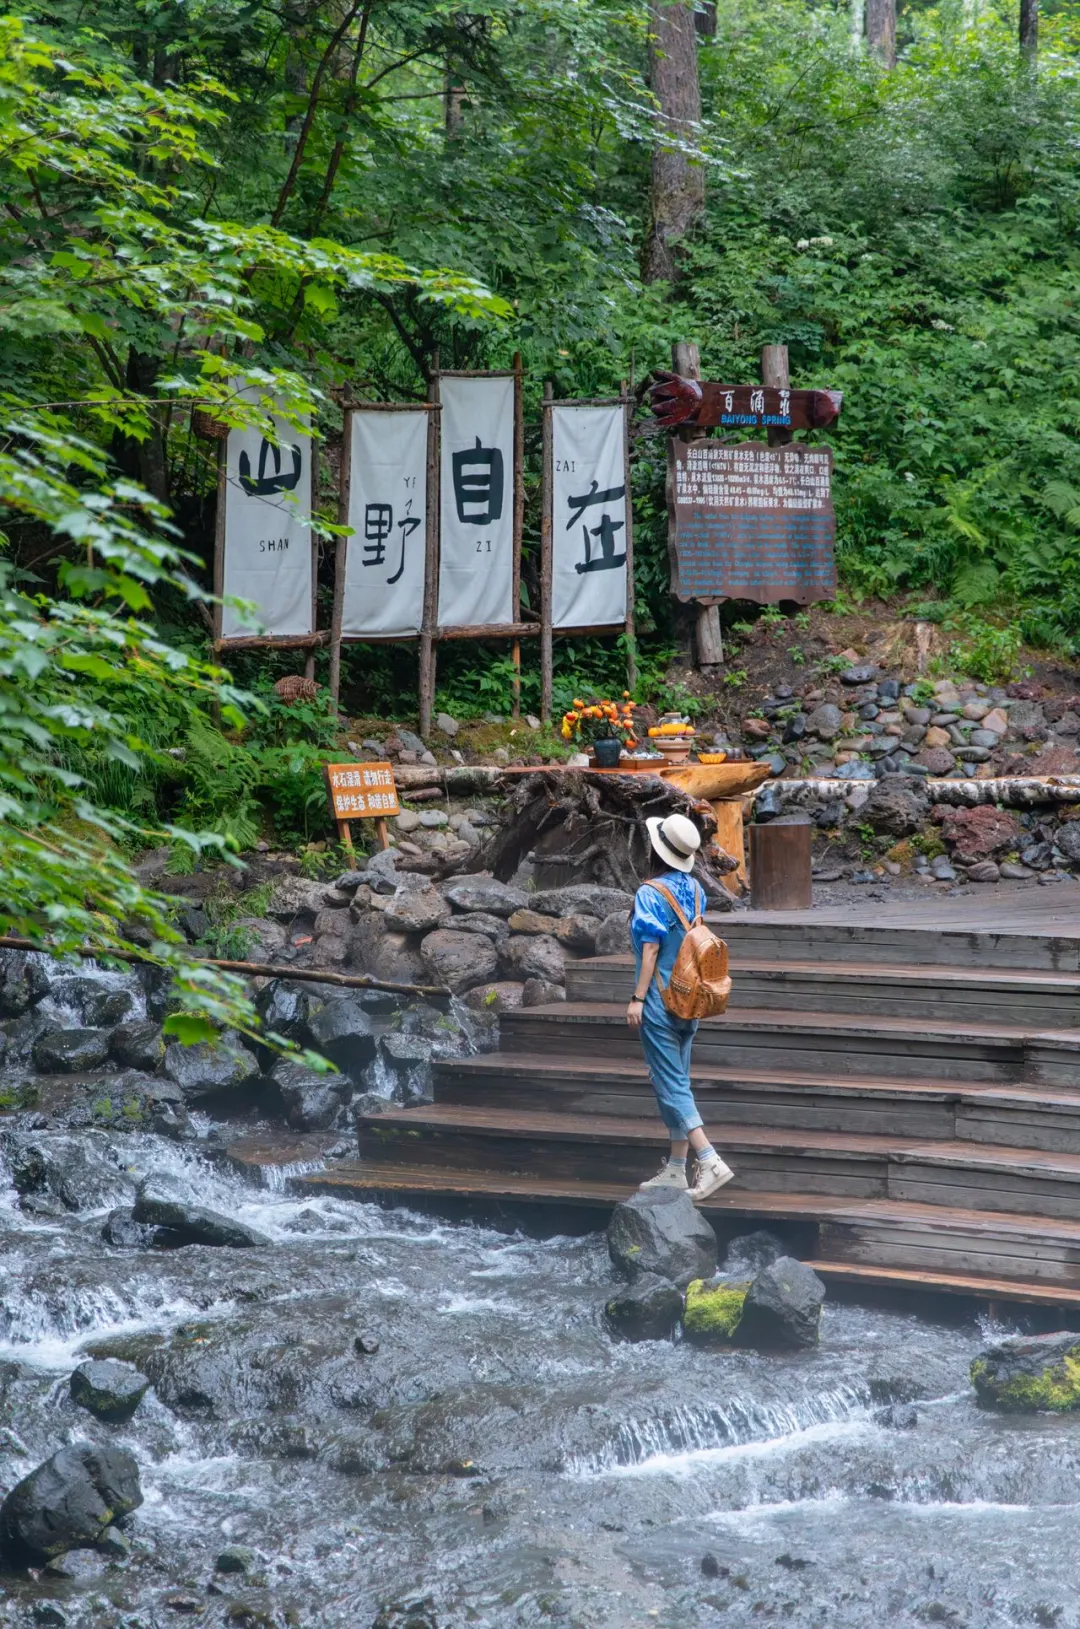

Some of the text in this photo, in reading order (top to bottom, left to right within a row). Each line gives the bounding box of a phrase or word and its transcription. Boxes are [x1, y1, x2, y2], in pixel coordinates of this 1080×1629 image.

[721, 414, 792, 425] BAIYONG SPRING
[238, 415, 302, 497] 山
[556, 460, 576, 473] ZAI
[451, 436, 505, 525] 自
[565, 479, 627, 575] 在
[259, 538, 290, 553] SHAN
[362, 499, 421, 585] 野
[475, 540, 492, 553] ZI
[336, 794, 365, 812] 保护生态
